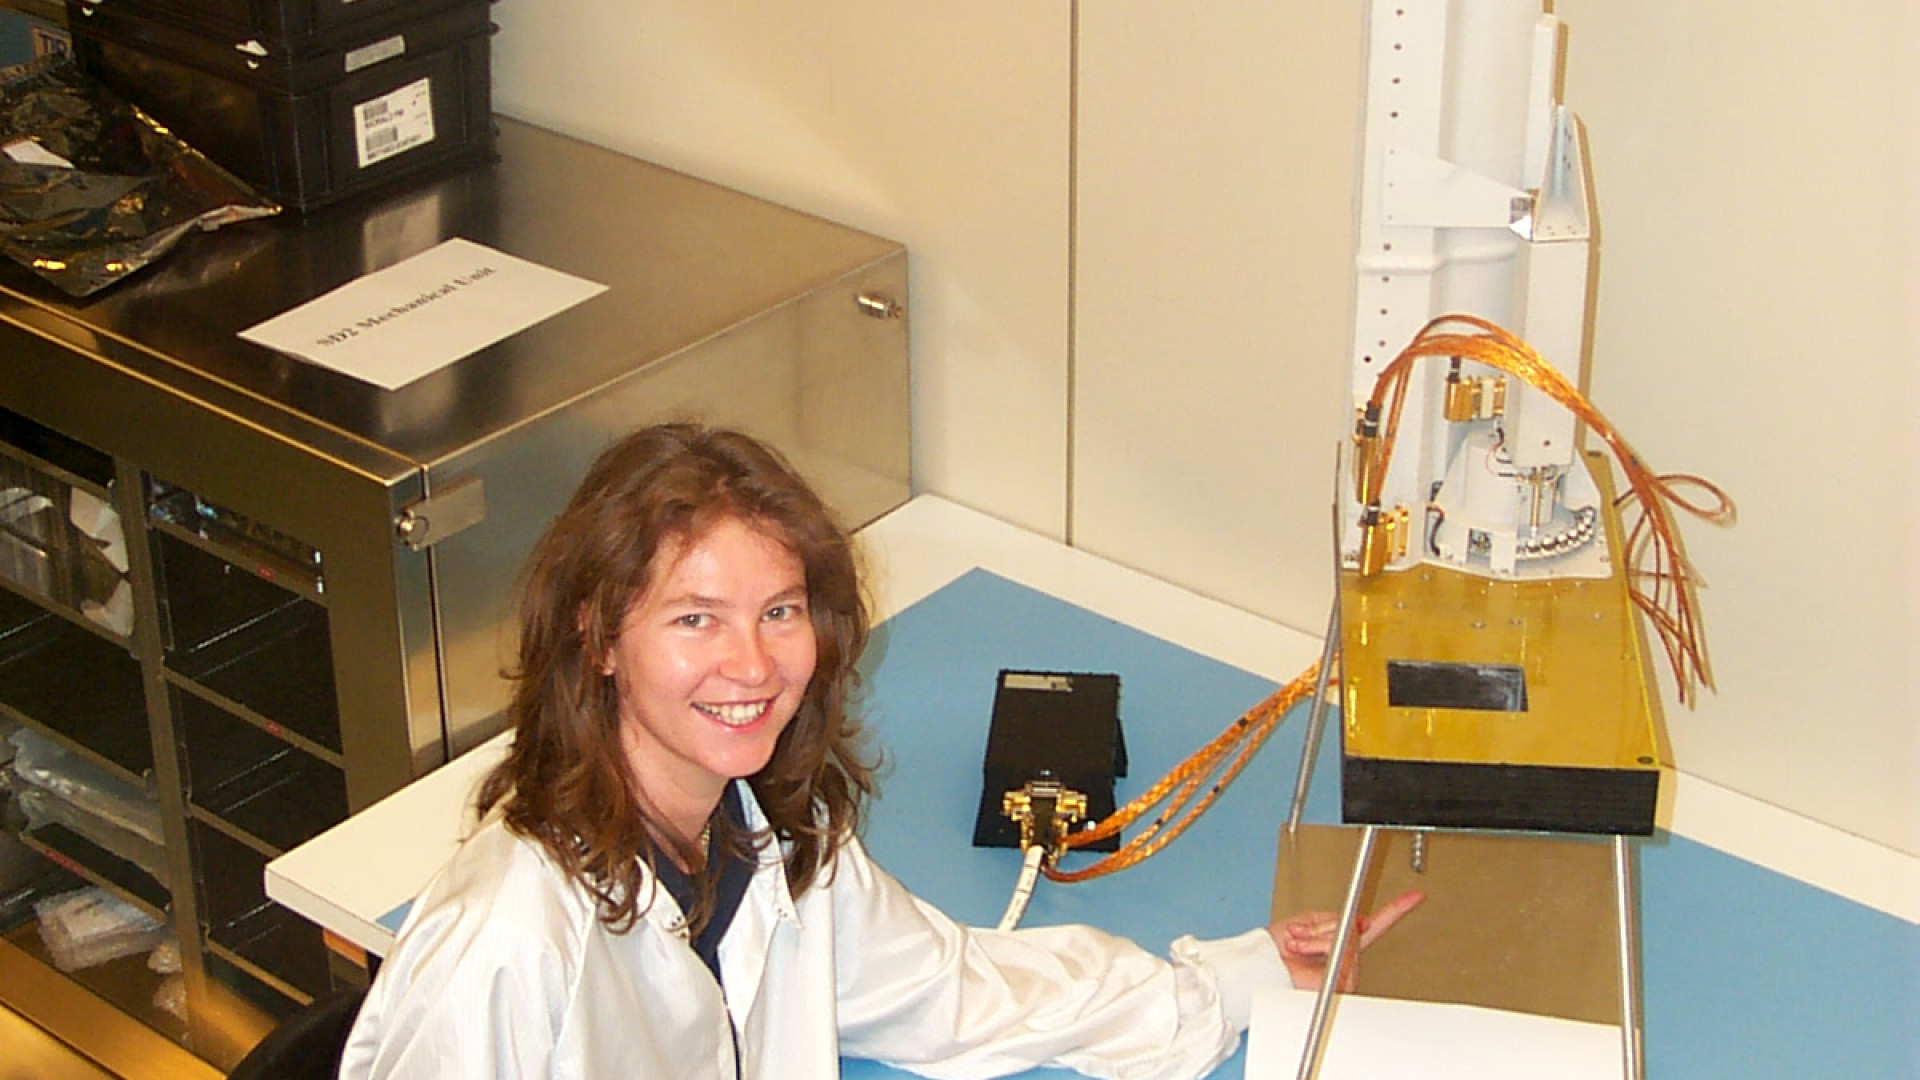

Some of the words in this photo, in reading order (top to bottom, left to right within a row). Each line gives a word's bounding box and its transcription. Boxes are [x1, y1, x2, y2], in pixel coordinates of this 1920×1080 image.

[316, 327, 358, 347] SD2
[356, 282, 457, 329] Mechanical
[454, 266, 496, 287] Unit
